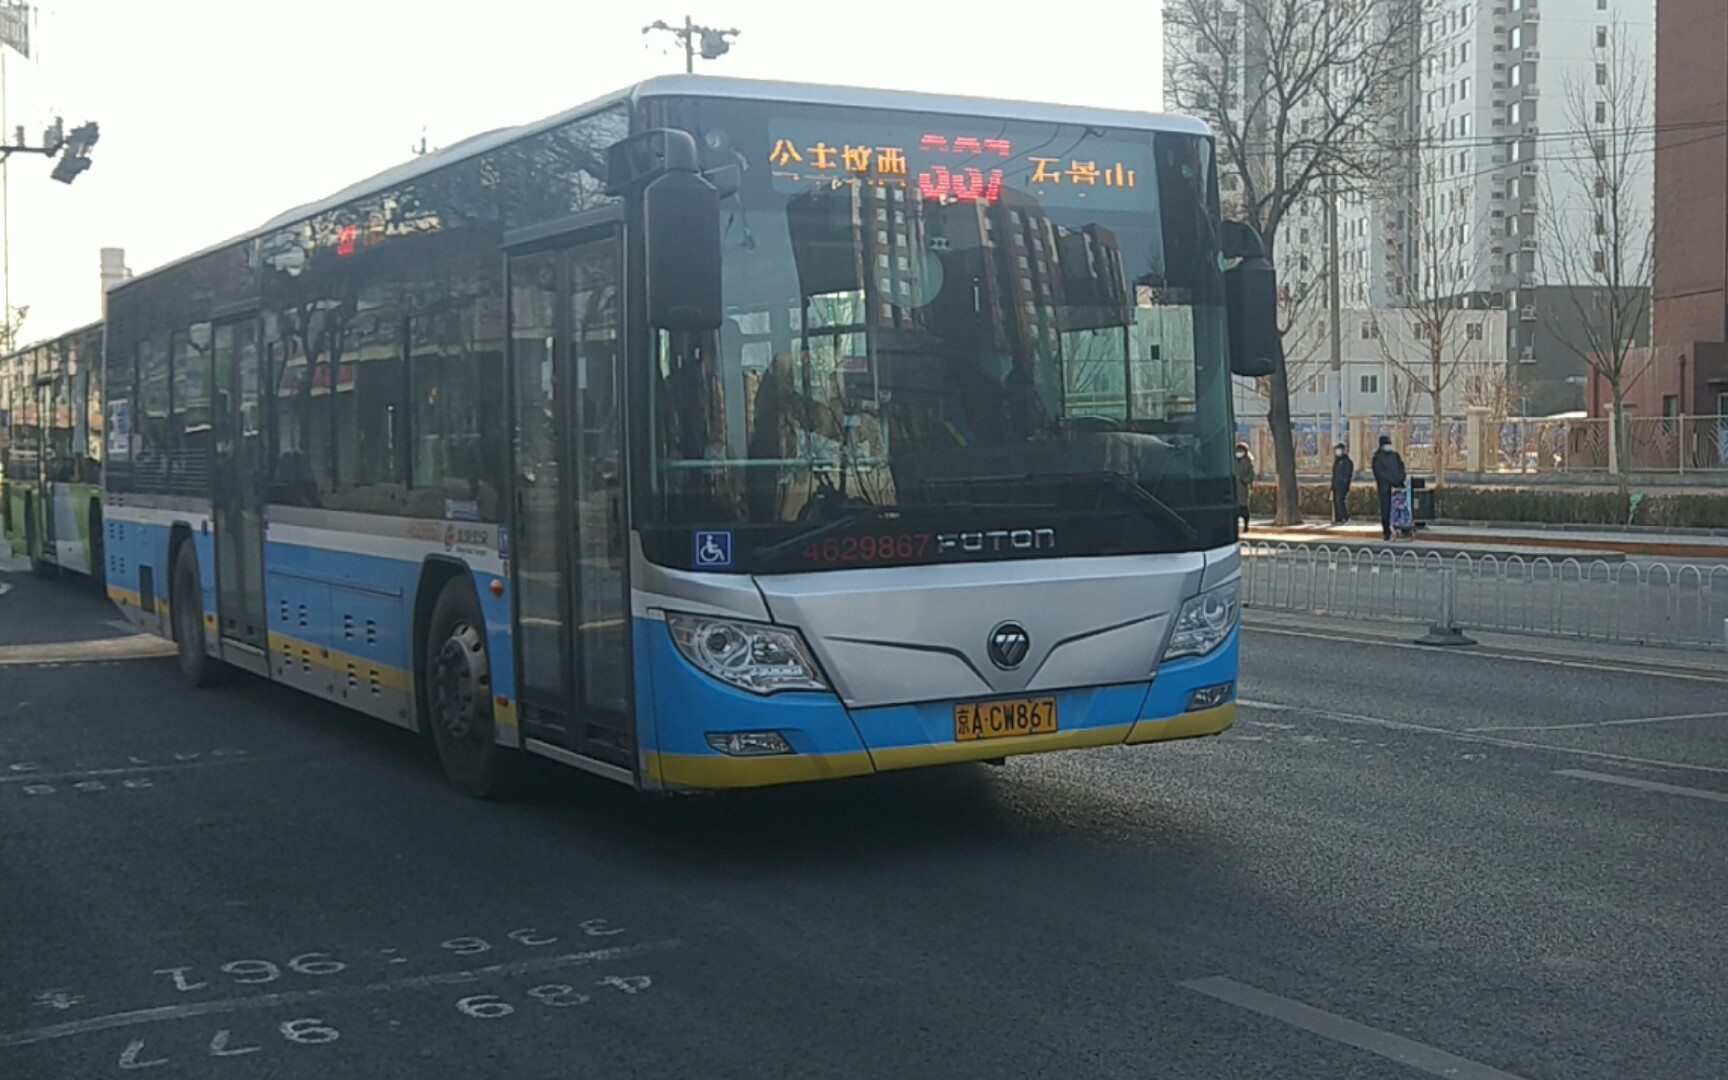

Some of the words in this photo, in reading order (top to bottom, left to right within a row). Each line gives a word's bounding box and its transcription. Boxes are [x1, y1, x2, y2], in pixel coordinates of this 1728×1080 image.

[1028, 156, 1135, 196] 石景山
[802, 535, 930, 561] 4629867
[937, 528, 1054, 553] FOTON
